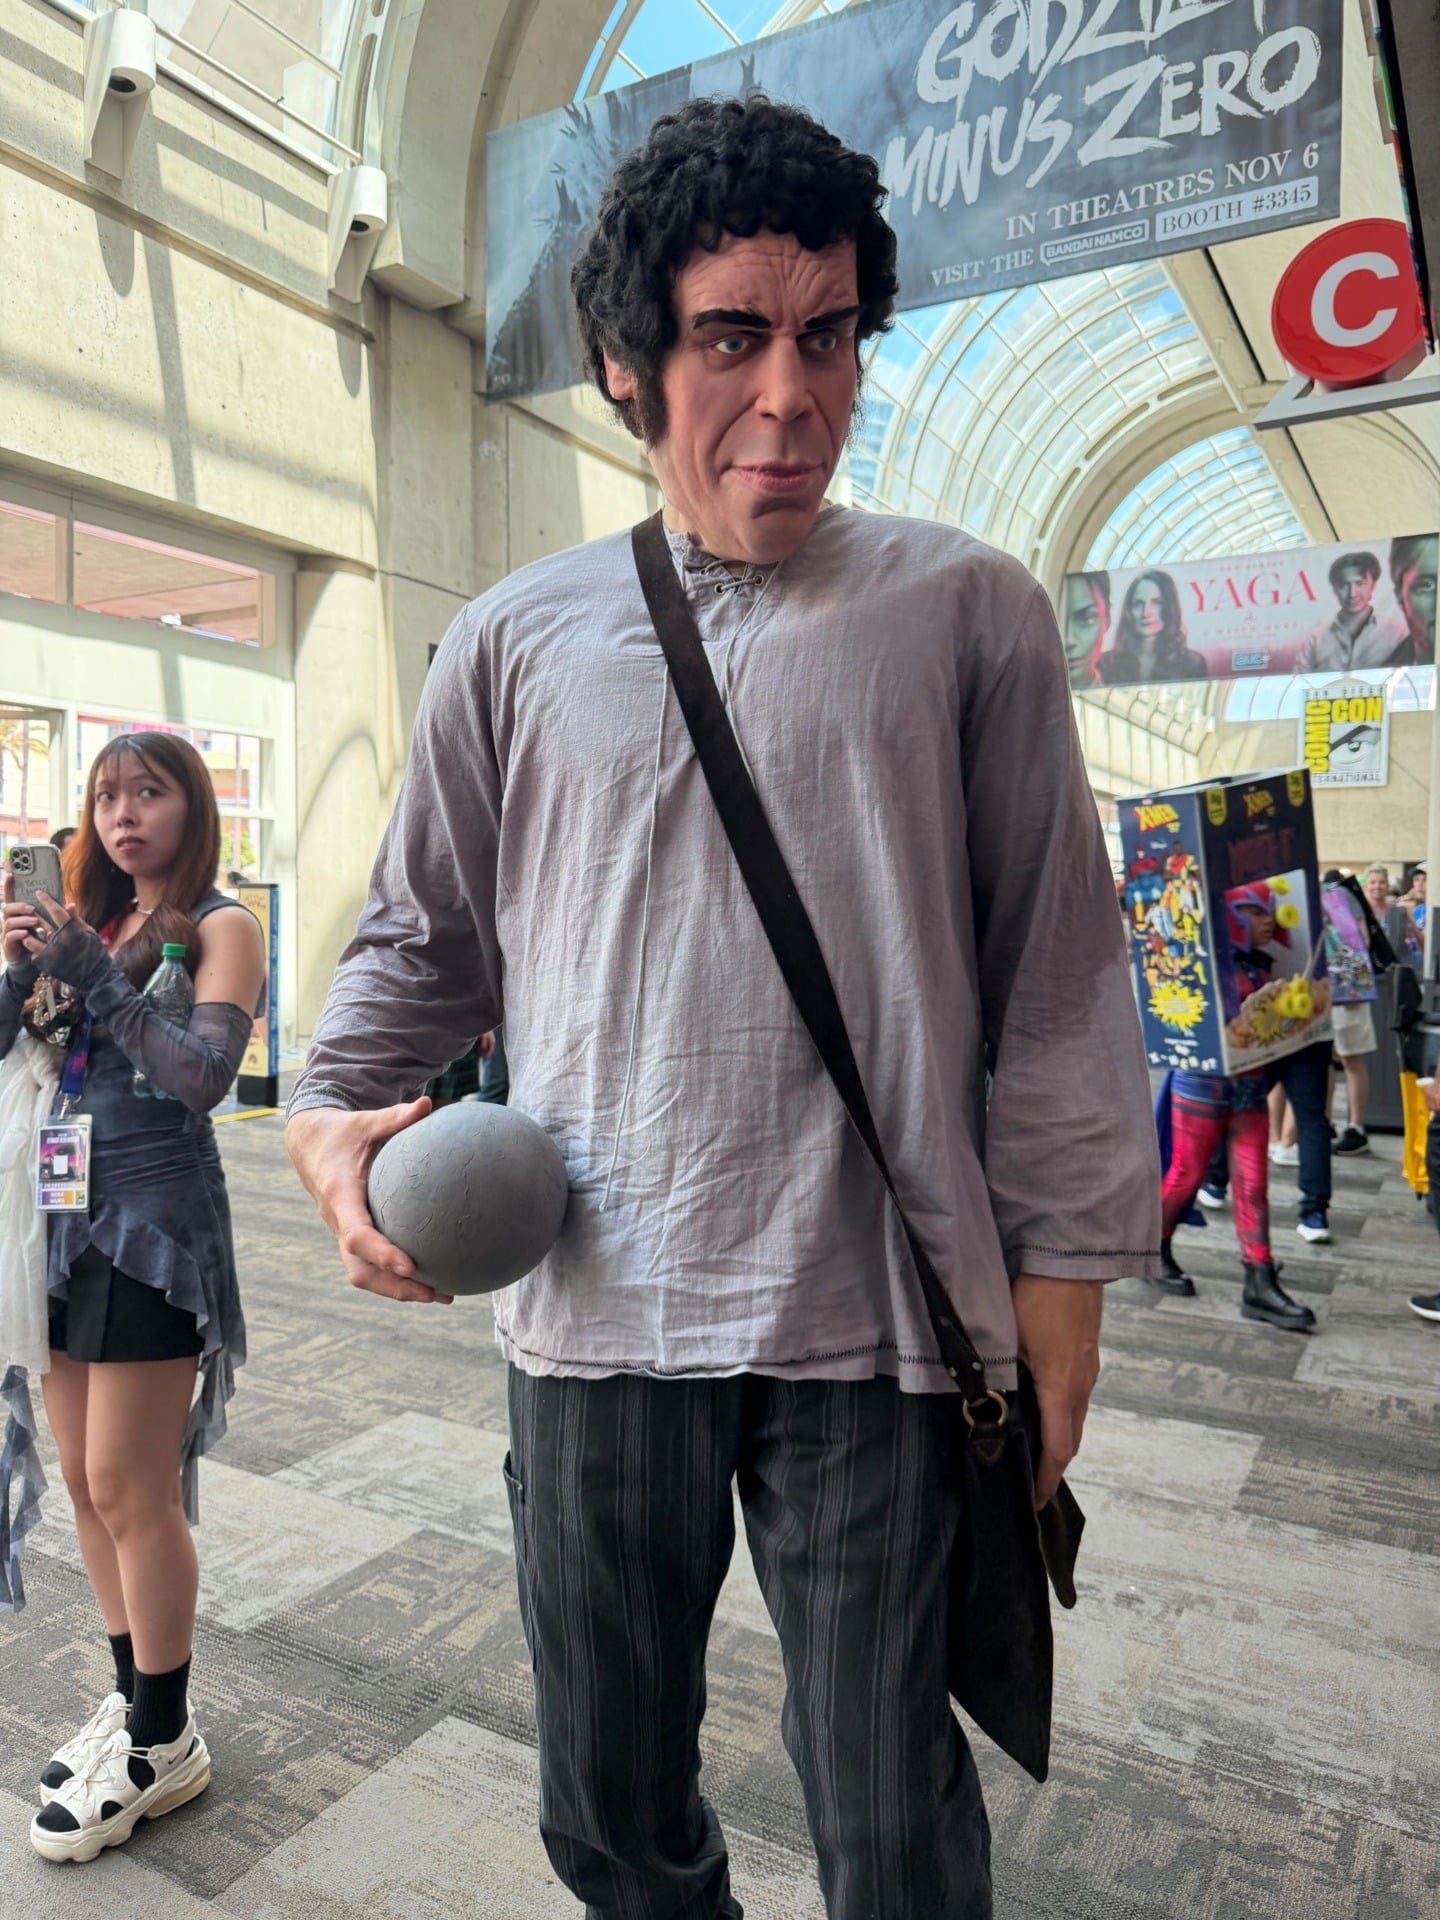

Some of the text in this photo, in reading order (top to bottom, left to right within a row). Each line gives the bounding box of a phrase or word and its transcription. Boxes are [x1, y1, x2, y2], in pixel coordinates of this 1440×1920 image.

[915, 0, 1265, 108] GODZIL
[883, 26, 1321, 218] MINUS ZERO
[931, 260, 984, 287] VISIT
[990, 248, 1034, 274] THE
[1161, 200, 1242, 235] BOOTH
[1251, 184, 1312, 214] #3345
[1005, 143, 1320, 242] IN THEATRES NOV 6
[1311, 251, 1400, 348] C
[1187, 570, 1317, 612] YAGA
[1304, 699, 1331, 774] COMIC
[1331, 696, 1383, 724] CON
